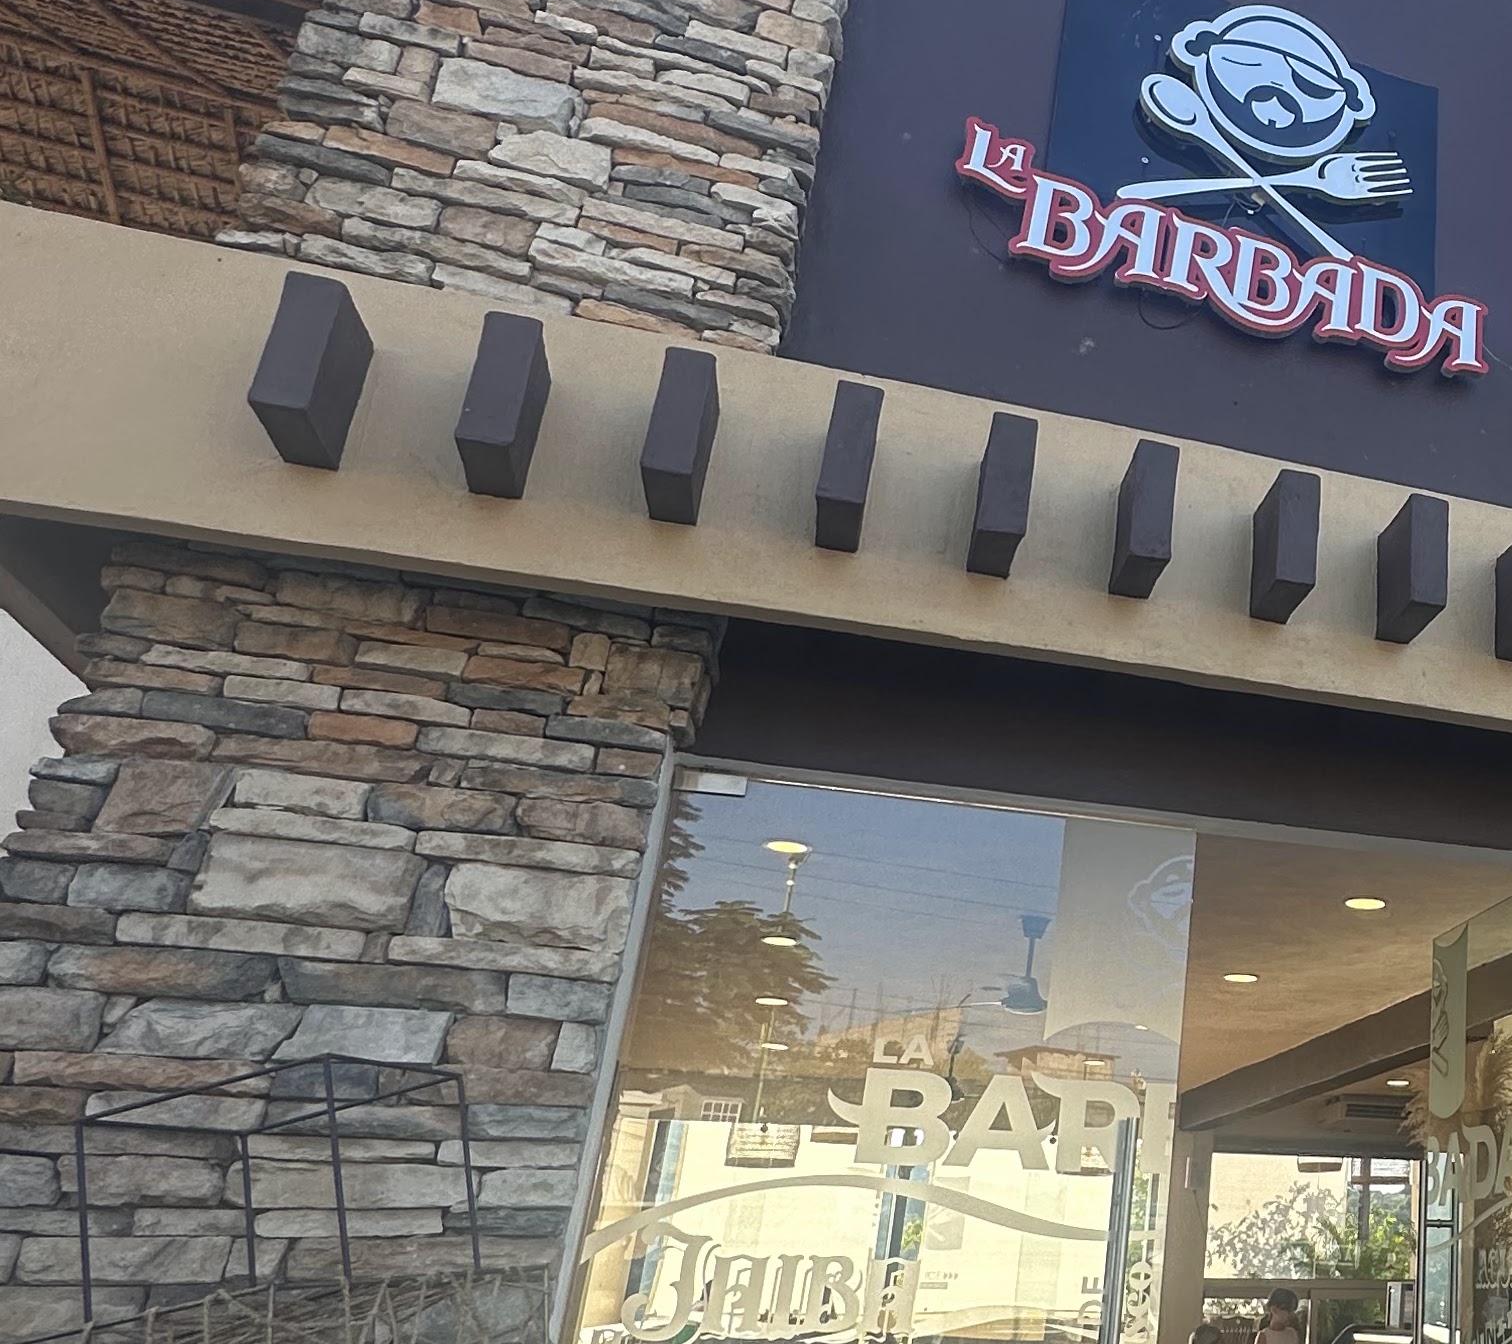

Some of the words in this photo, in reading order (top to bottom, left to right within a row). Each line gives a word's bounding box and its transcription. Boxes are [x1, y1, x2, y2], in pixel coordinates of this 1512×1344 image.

[959, 120, 1032, 196] LA
[1010, 178, 1486, 371] BARBADA
[873, 1034, 934, 1065] LA
[1077, 1276, 1104, 1325] DE
